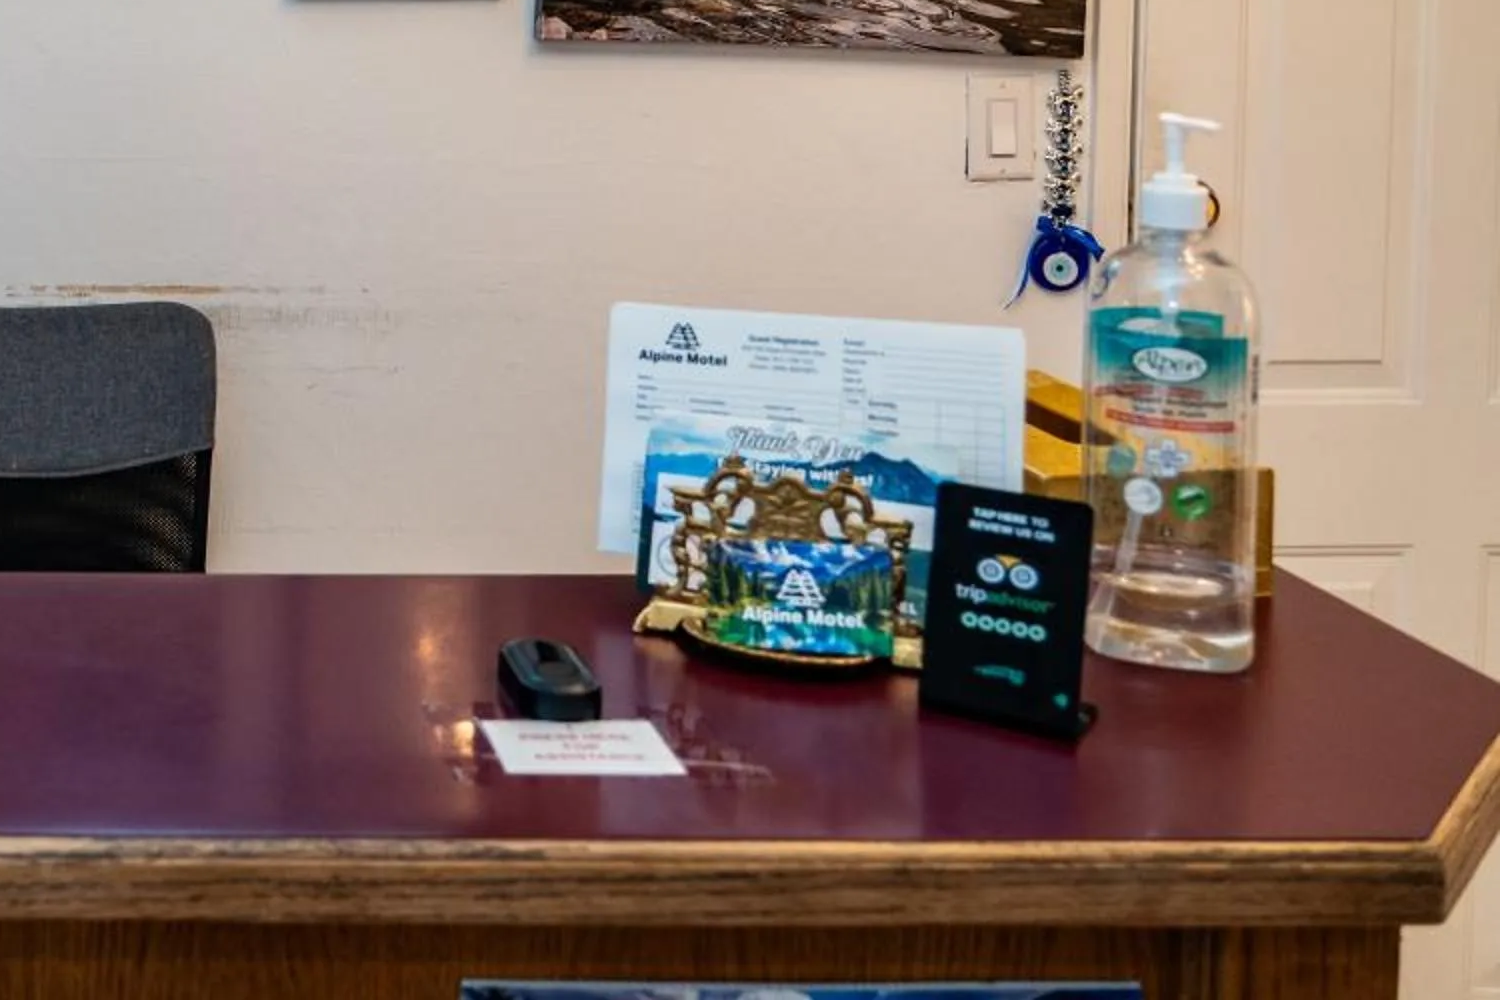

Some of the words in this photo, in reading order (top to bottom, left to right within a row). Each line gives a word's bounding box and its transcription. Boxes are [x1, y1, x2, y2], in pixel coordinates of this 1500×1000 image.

[639, 349, 683, 364] Alpine
[687, 352, 727, 367] Motel
[968, 519, 1013, 535] REVIEW
[1015, 526, 1032, 539] US
[1034, 530, 1055, 542] ON
[1032, 516, 1049, 528] TO
[955, 583, 1049, 613] tripadvisor
[742, 606, 804, 627] Alpine
[807, 609, 864, 628] Motel
